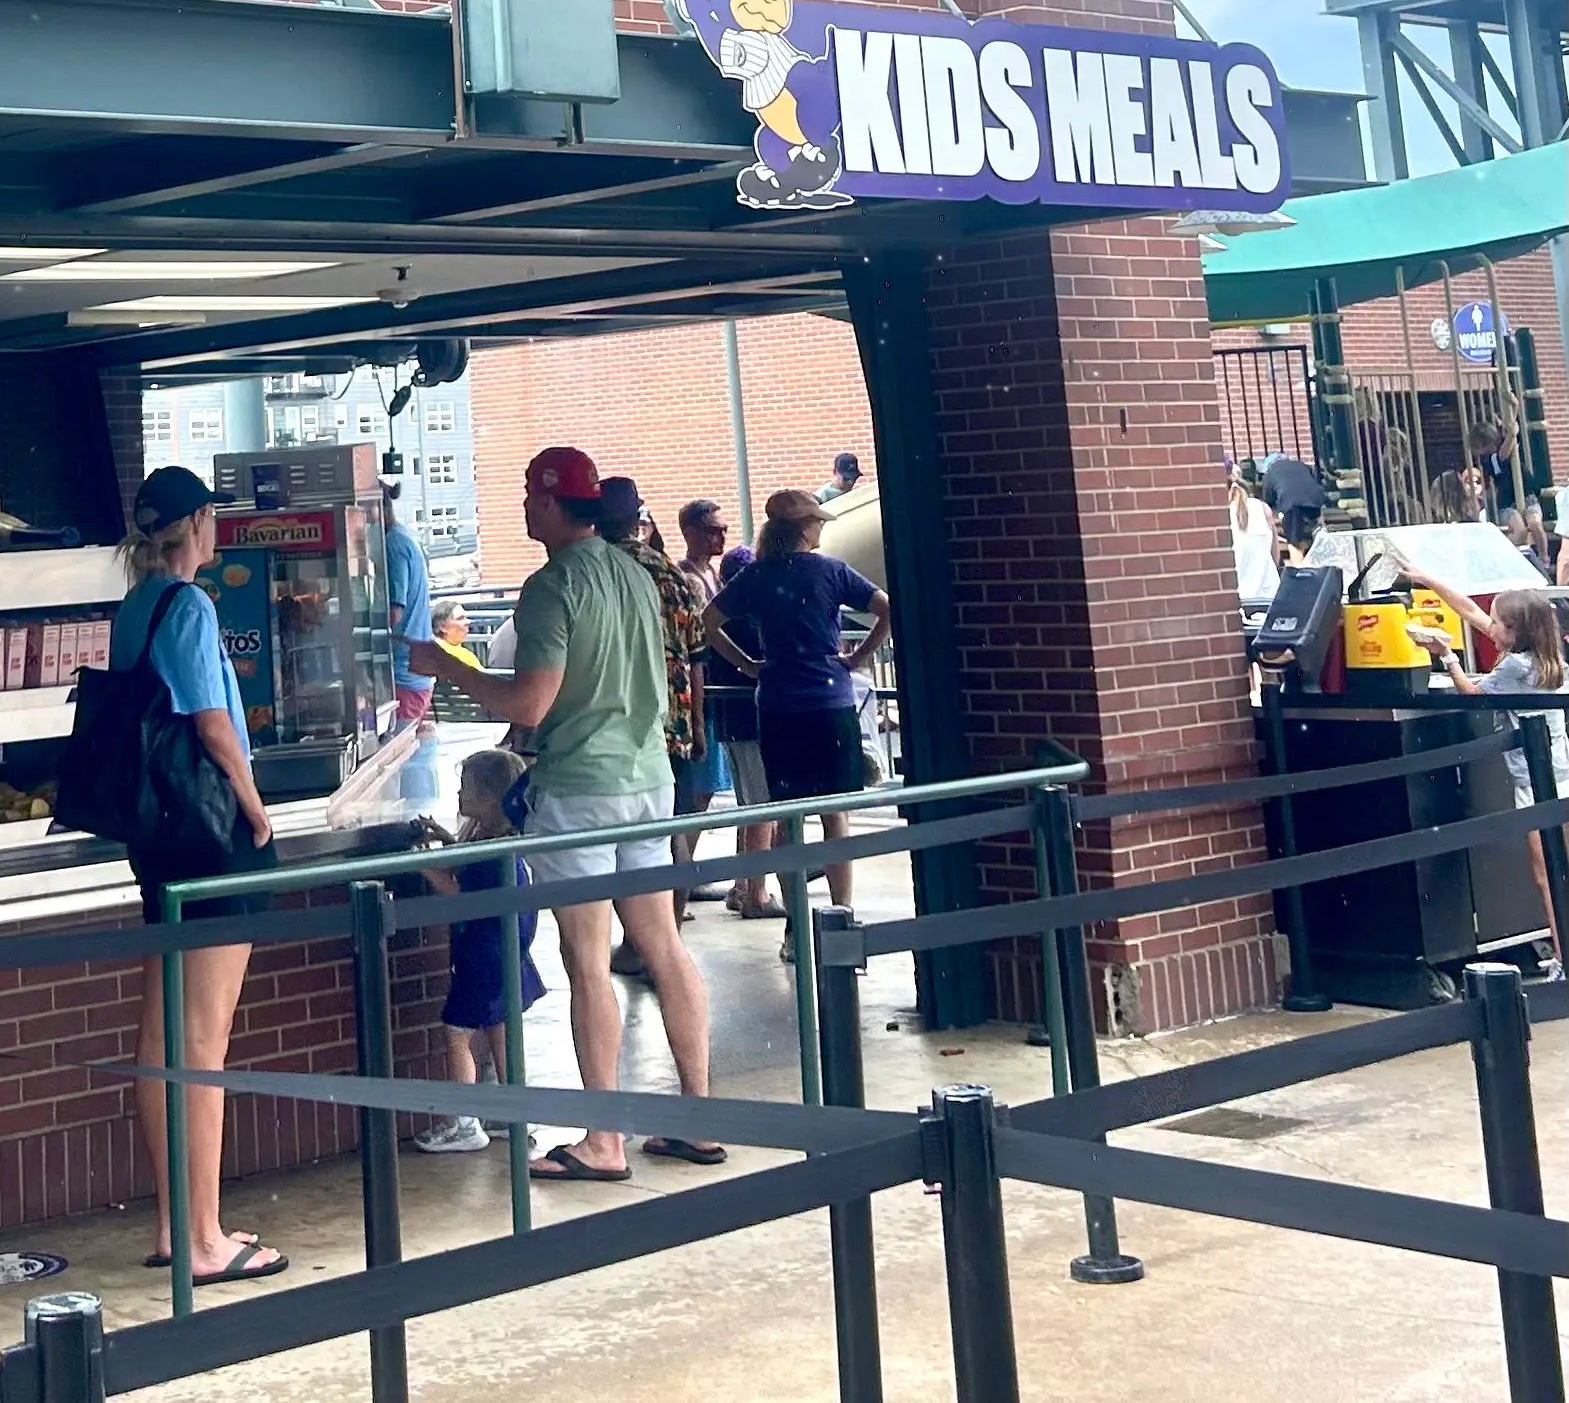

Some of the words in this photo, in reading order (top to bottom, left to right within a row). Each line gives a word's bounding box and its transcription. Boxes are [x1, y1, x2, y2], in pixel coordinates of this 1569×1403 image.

[832, 27, 1040, 182] KIDS
[1042, 47, 1281, 195] MEALS
[236, 525, 319, 545] Bavarian
